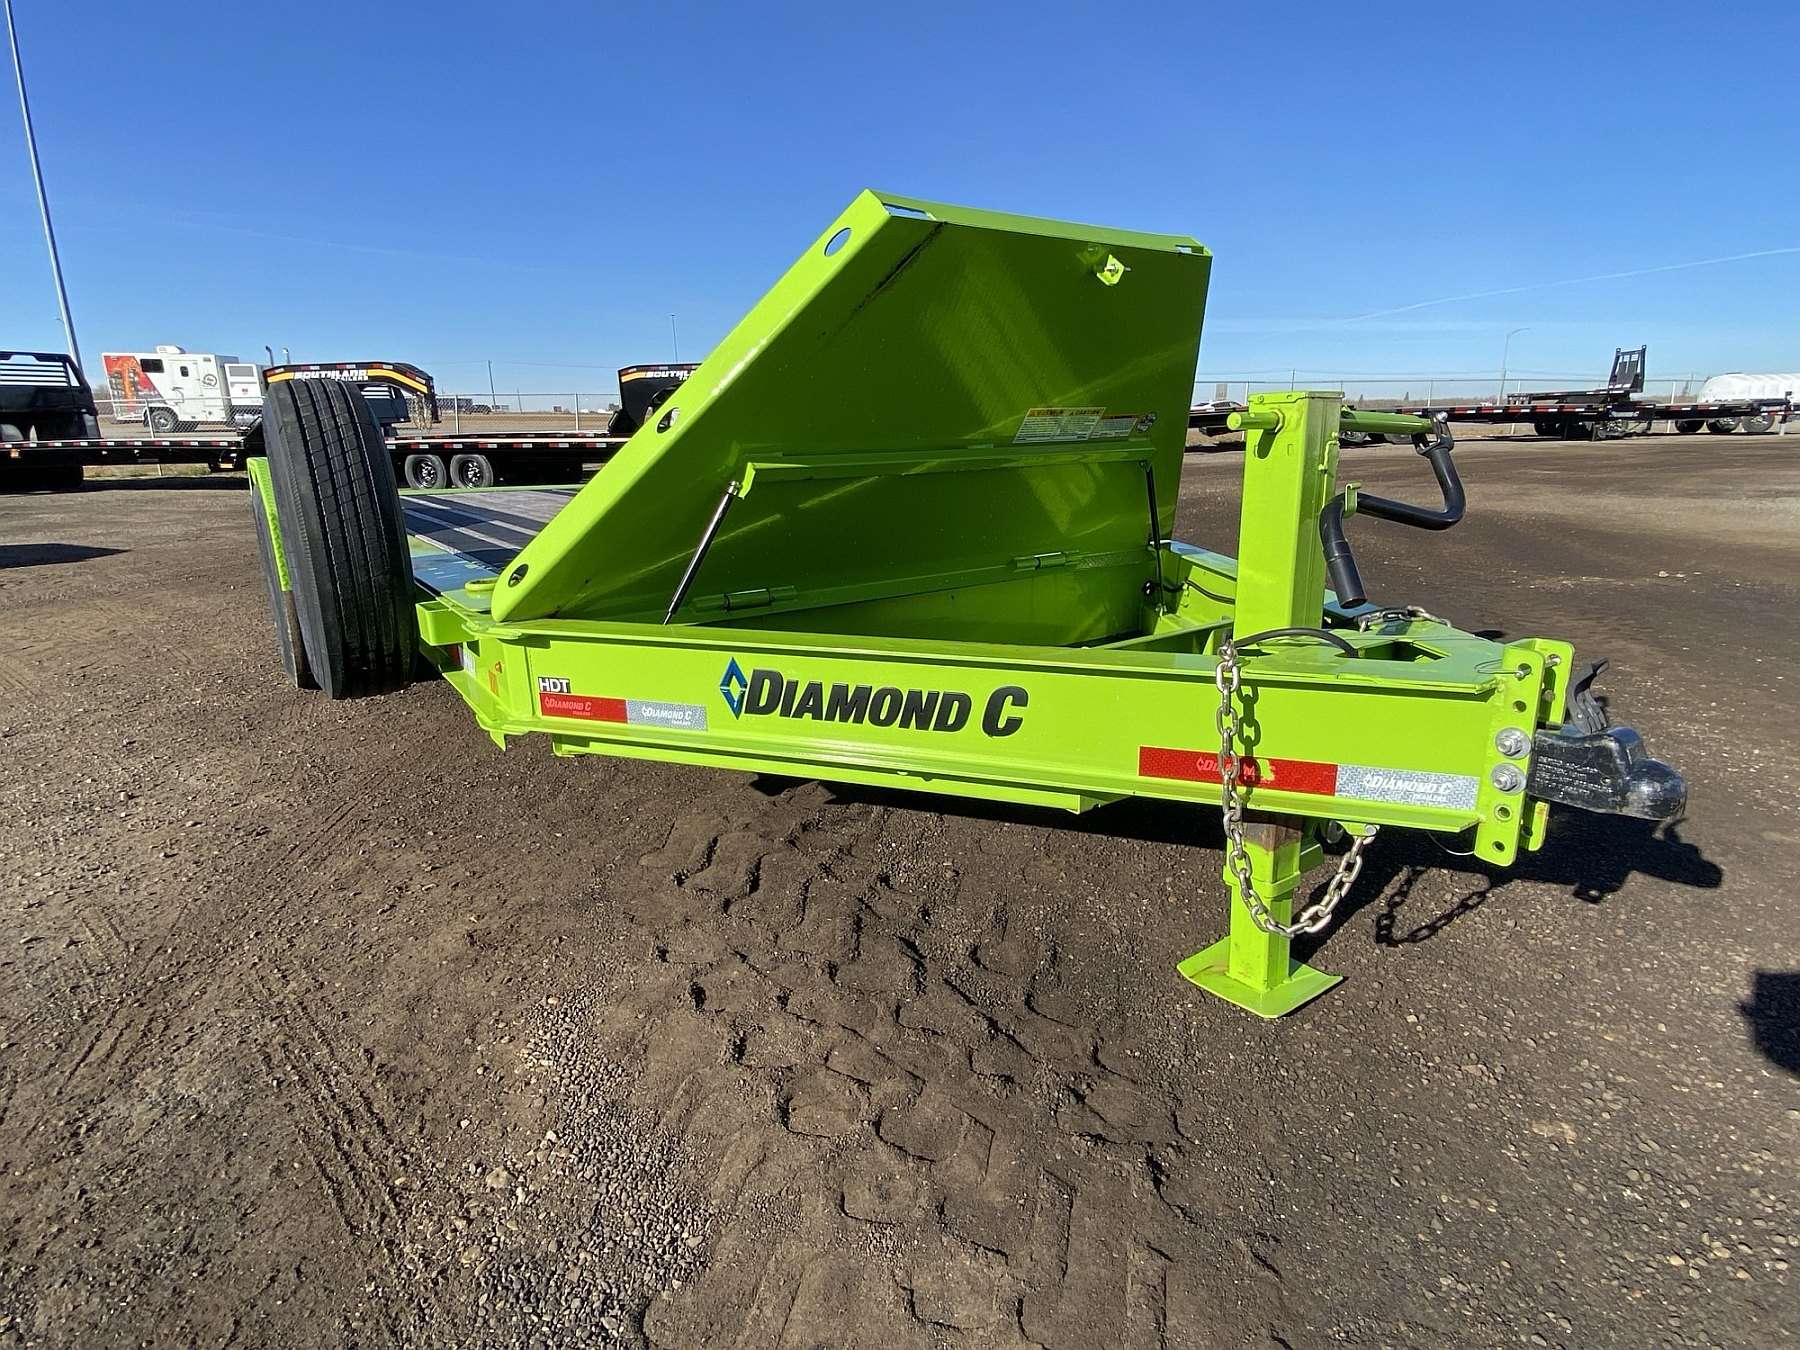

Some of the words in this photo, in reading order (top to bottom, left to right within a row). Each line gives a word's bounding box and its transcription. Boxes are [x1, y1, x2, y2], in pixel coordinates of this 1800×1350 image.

[294, 370, 367, 379] SOUTHLAND
[645, 370, 697, 378] SOUTHL
[538, 678, 570, 693] HDT
[549, 698, 584, 711] DIAMOND
[585, 701, 592, 711] C
[744, 668, 972, 733] DIAMOND
[982, 685, 1029, 738] C
[646, 707, 684, 720] DIAMOND
[686, 711, 693, 721] C
[1372, 775, 1440, 793] DIAMOND
